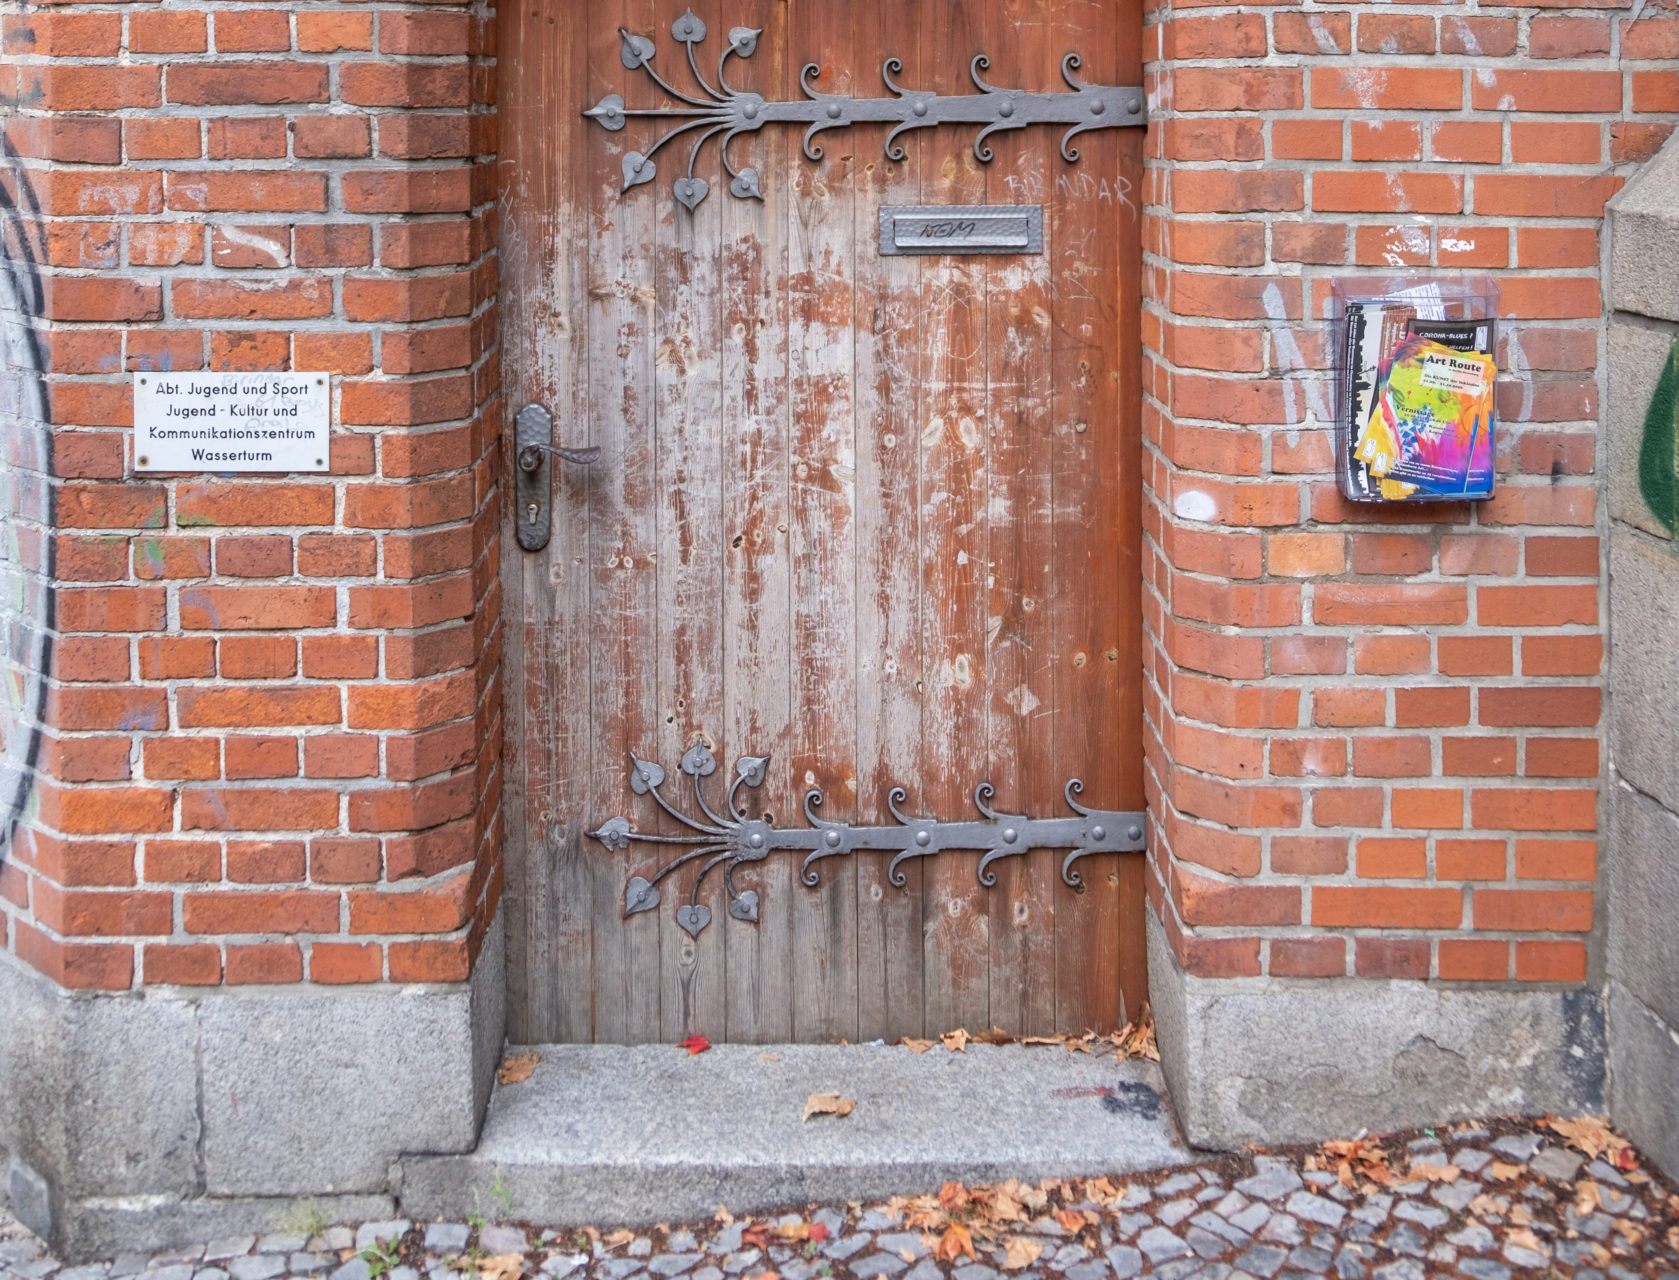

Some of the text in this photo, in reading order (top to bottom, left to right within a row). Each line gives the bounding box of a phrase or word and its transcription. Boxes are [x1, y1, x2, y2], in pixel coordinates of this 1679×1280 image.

[1426, 354, 1446, 366] Art
[1448, 358, 1482, 373] Route
[155, 382, 309, 398] Abt. Jugend und Sport
[166, 404, 216, 420] Jugend
[230, 404, 269, 417] Kultur
[273, 404, 298, 417] und
[1396, 404, 1436, 418] Vernissage
[149, 426, 316, 440] Kommunikationszentrum
[191, 447, 273, 462] Wasserturm
